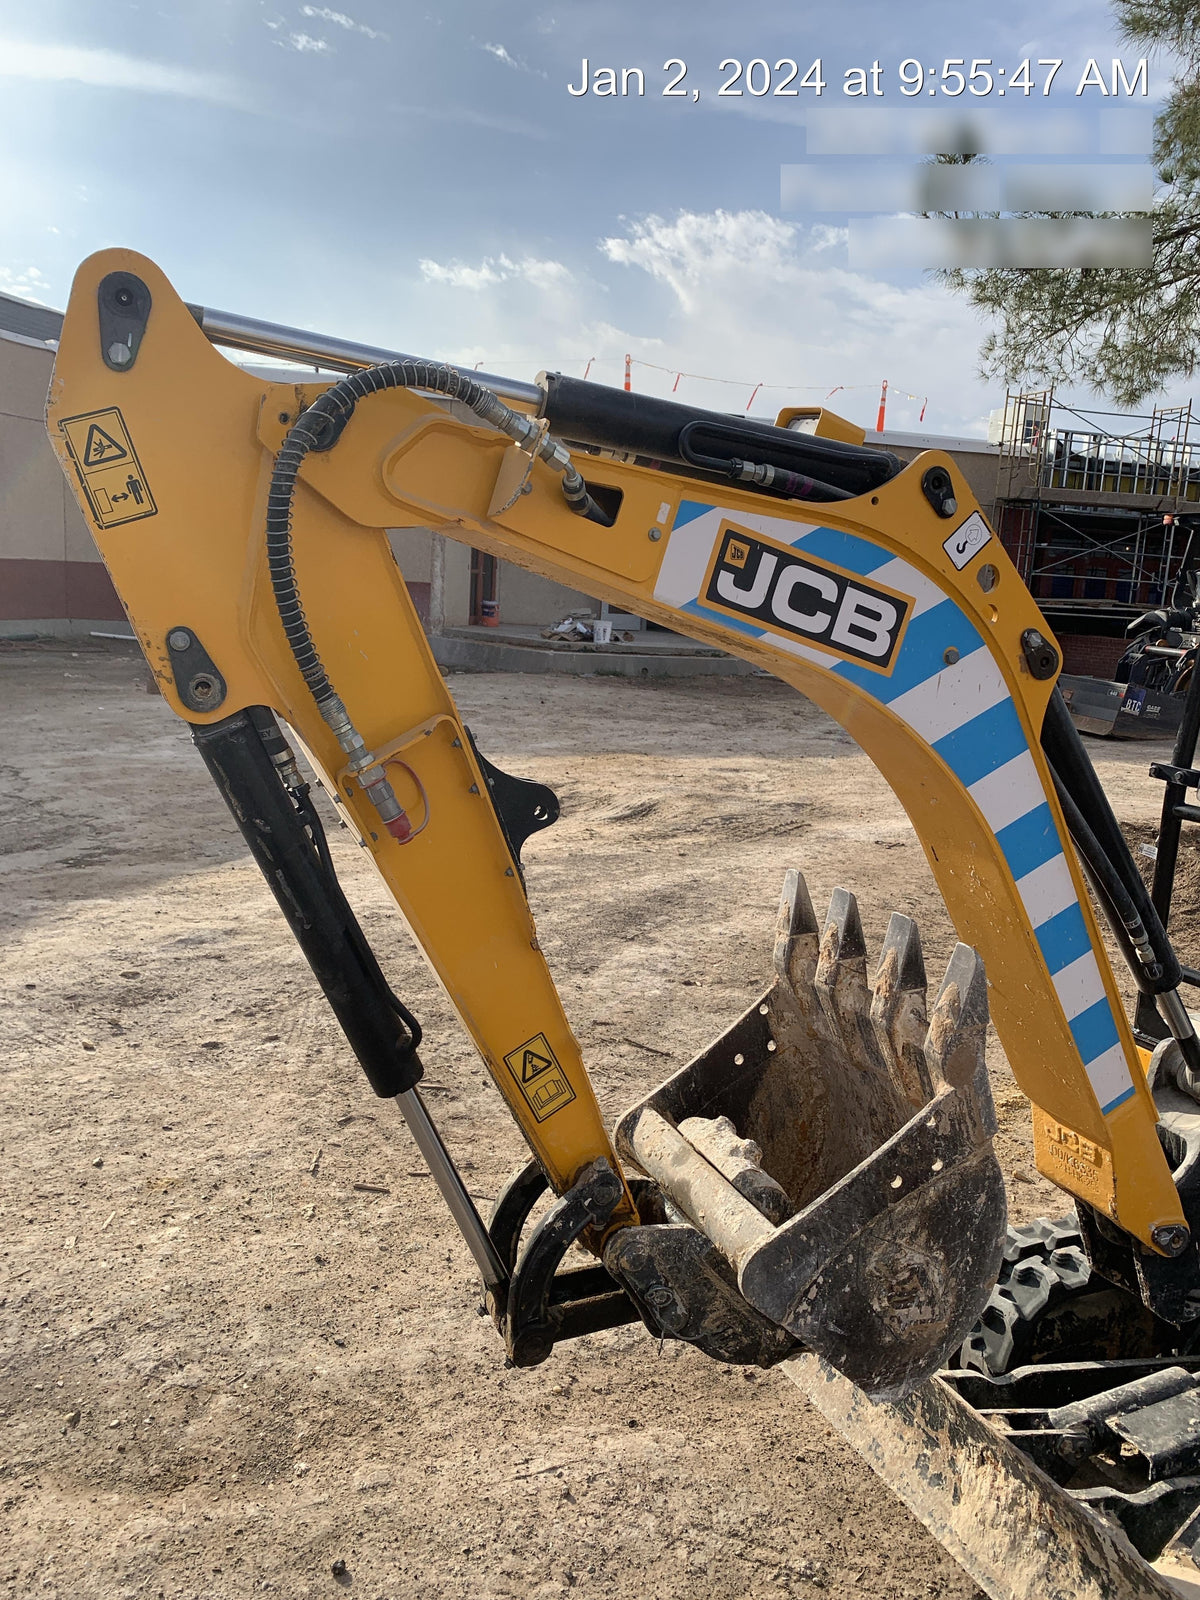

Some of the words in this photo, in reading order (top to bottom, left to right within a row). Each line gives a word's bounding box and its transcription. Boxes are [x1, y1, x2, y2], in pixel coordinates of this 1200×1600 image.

[731, 545, 745, 559] JCB
[716, 551, 898, 657] JCB
[1126, 698, 1142, 712] BTC
